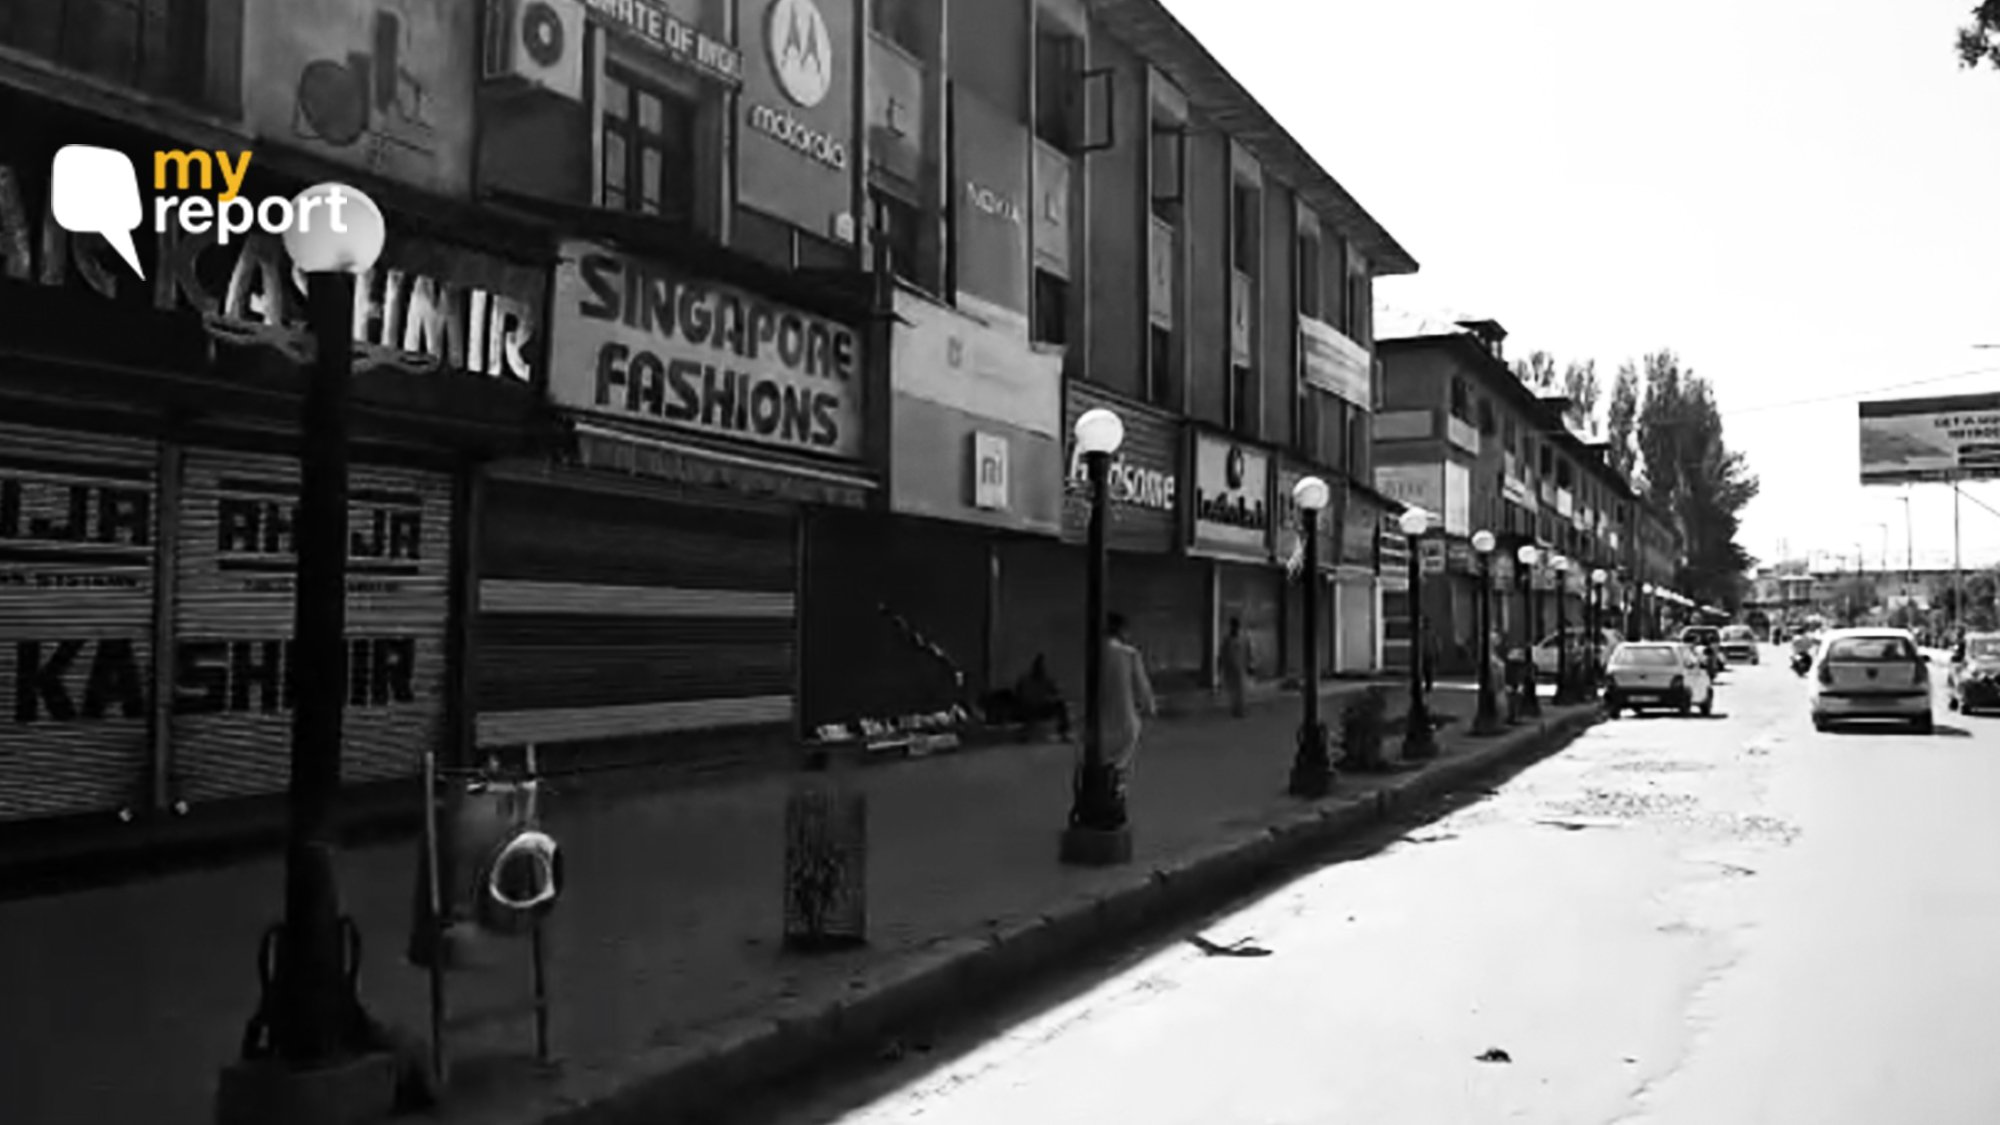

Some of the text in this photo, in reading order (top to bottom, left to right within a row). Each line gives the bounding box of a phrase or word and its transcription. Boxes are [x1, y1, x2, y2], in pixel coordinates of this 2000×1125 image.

[664, 18, 694, 52] OF
[752, 104, 846, 169] motorola
[153, 205, 532, 381] KAHMIR
[578, 254, 853, 381] SINGAPORE
[594, 342, 839, 447] FASHIONS
[1071, 440, 1175, 510] hdsome
[218, 498, 420, 559] AHJA
[15, 638, 415, 722] KASHIR
